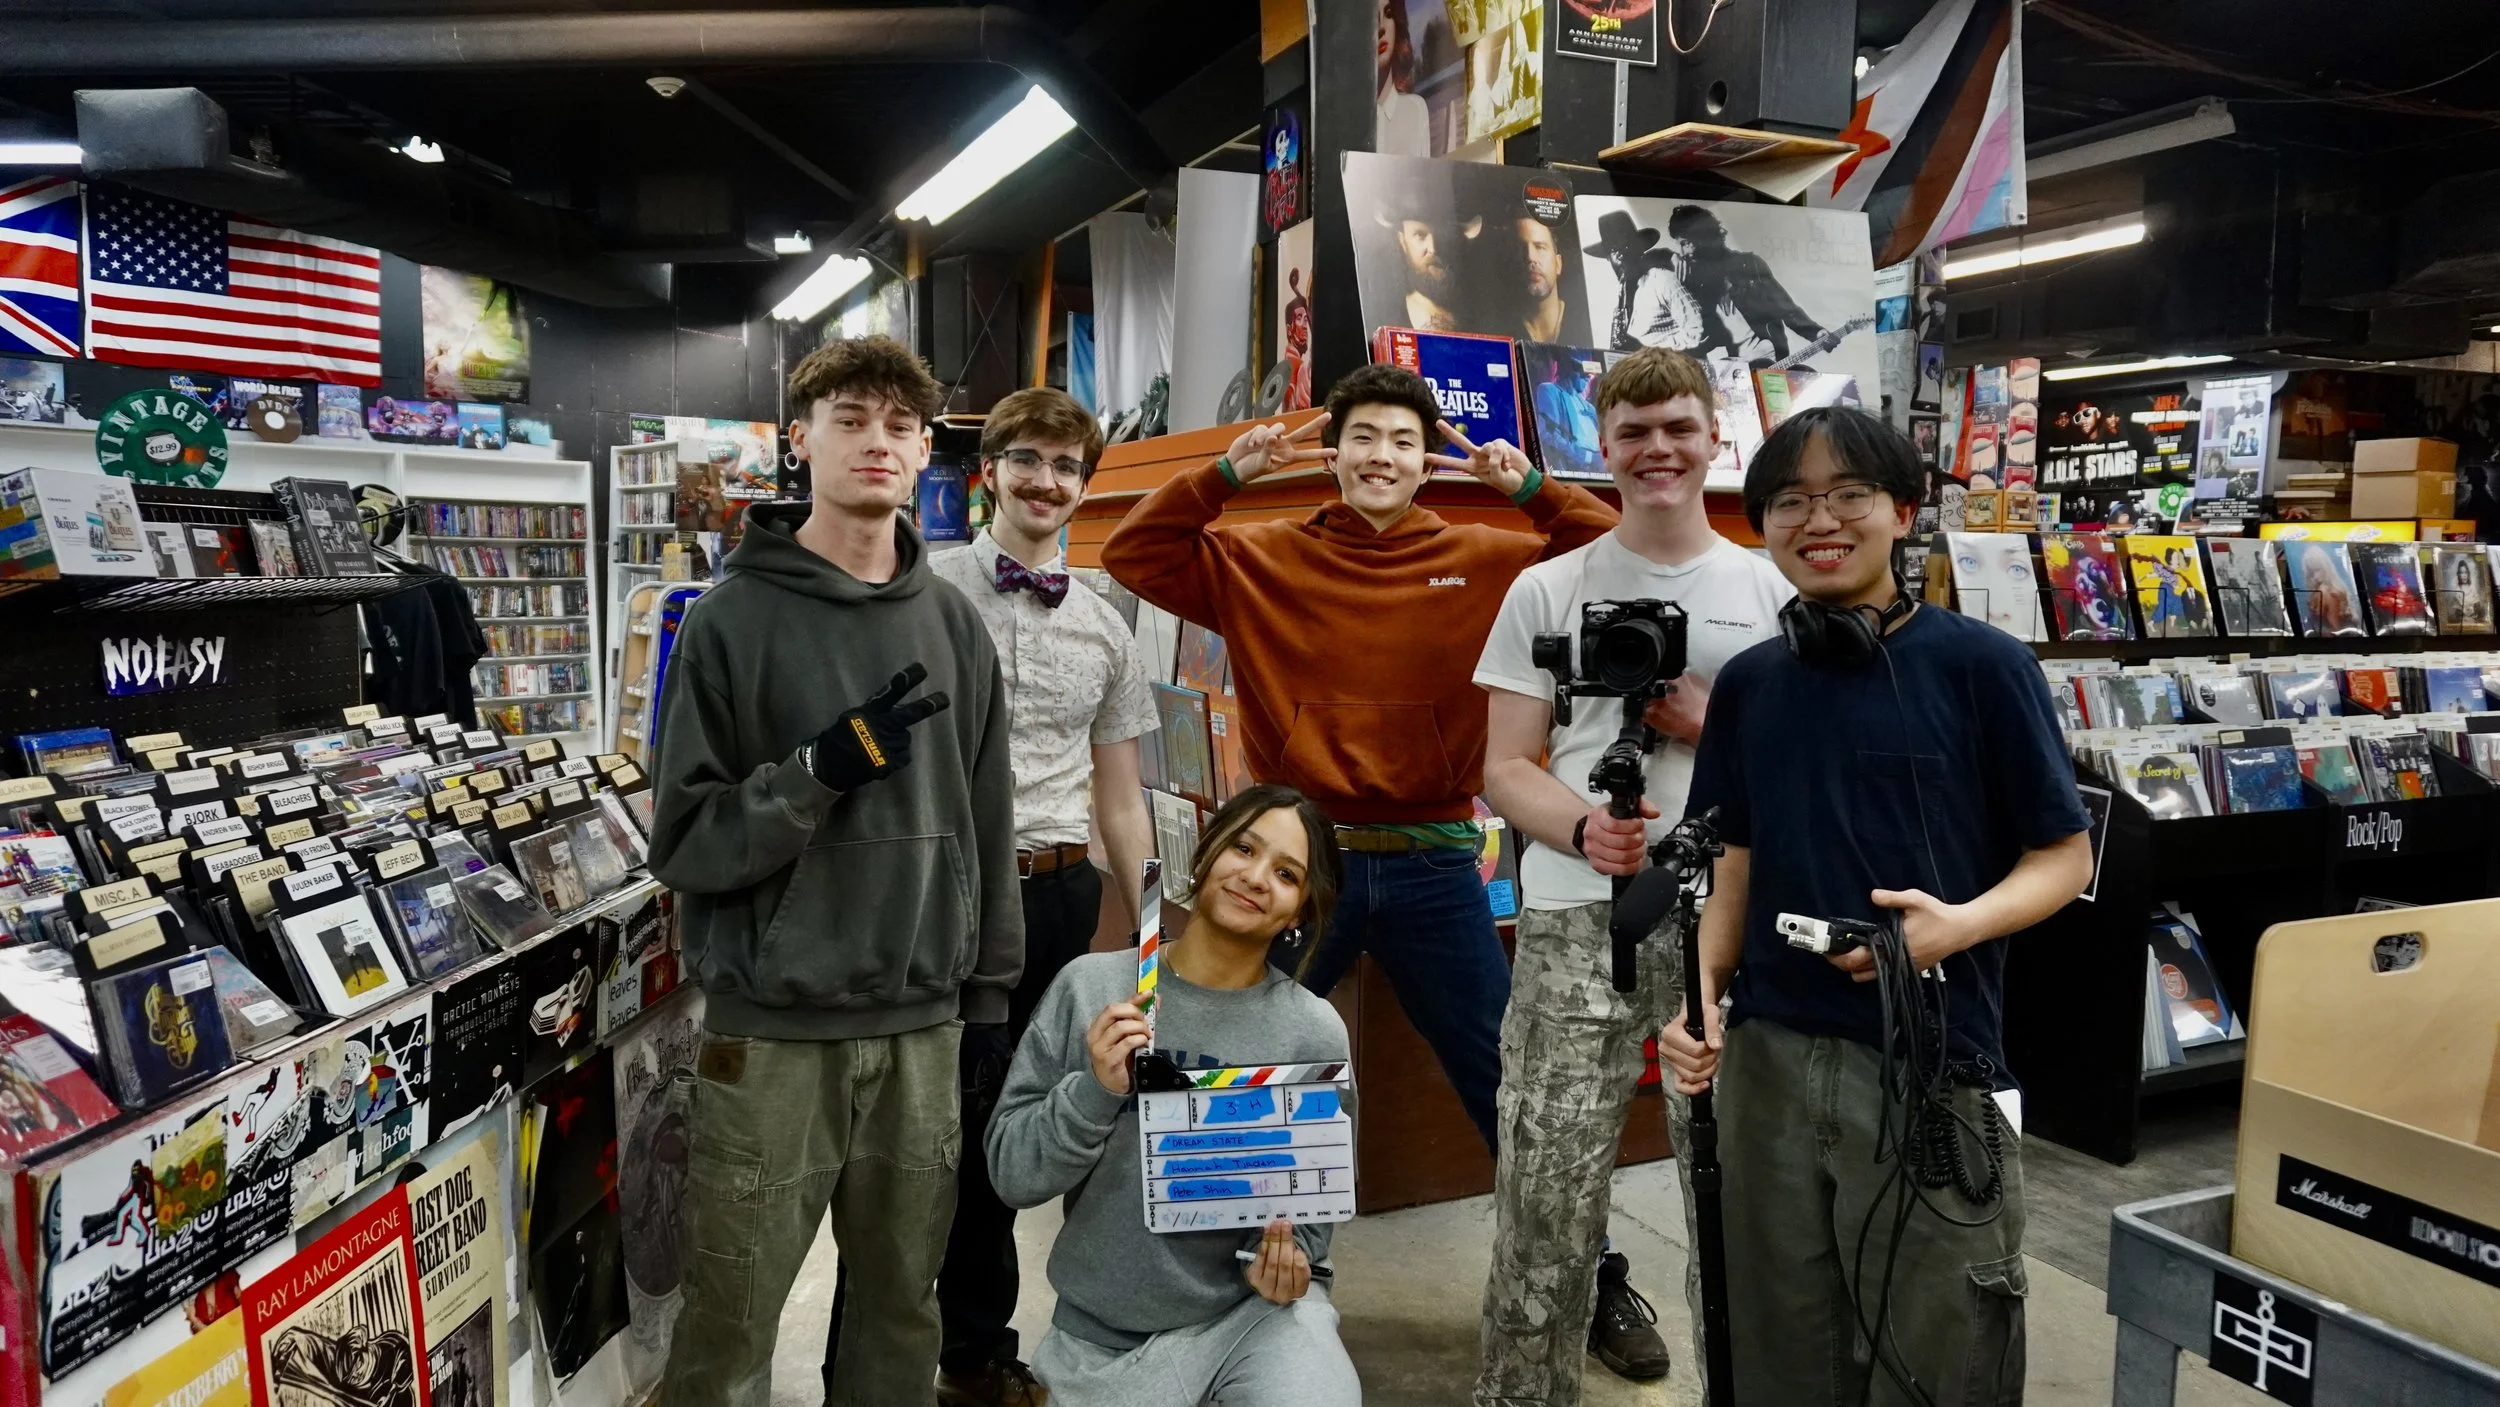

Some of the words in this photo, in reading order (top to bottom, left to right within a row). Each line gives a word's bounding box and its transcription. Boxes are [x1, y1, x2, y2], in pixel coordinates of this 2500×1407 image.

[1591, 13, 1621, 32] 25TH
[1568, 28, 1643, 44] ANNIVERSARY
[1572, 37, 1640, 51] COLLECTION
[233, 380, 265, 395] WORLD
[267, 384, 281, 394] BE
[281, 387, 303, 397] FREE
[1448, 378, 1462, 389] THE
[1424, 377, 1489, 416] BEATLES
[257, 400, 291, 414] DVDS
[101, 396, 209, 465] VINTAGE
[149, 442, 178, 456] $12.99
[2044, 457, 2082, 484] R.O.C.
[2085, 450, 2138, 481] STARS
[1428, 576, 1467, 587] XLARGE
[101, 632, 226, 690] NOEASY
[468, 733, 493, 744] CARAVAN
[246, 762, 266, 773] BISHOP
[266, 759, 285, 770] BRIGGS
[566, 762, 587, 773] CAMEL
[604, 758, 620, 768] CAKE
[2143, 764, 2171, 778] Secret
[492, 775, 499, 785] B
[275, 792, 312, 808] BLEACHERS
[103, 806, 124, 815] BLACK
[457, 804, 485, 819] BOSTON
[497, 810, 512, 823] BON
[512, 808, 527, 820] JOVI
[118, 819, 133, 829] BLACK
[131, 827, 143, 836] NEW
[144, 822, 158, 832] ROAD
[202, 825, 228, 837] ANDREW
[228, 822, 244, 834] BIRD
[2347, 810, 2402, 851] Rock/Pop
[271, 830, 287, 844] BIG
[287, 825, 311, 839] THIEF
[313, 842, 331, 855] FROND
[382, 857, 399, 872] JEFF
[400, 851, 420, 866] BECK
[238, 872, 258, 886] THE
[261, 864, 286, 881] BAND
[291, 879, 313, 892] JULIEN
[313, 872, 336, 885] BAKER
[94, 890, 129, 908] MISC.
[132, 886, 142, 899] A
[443, 998, 477, 1026] ARCTIC
[480, 976, 520, 1006] MONKEYS
[500, 996, 519, 1014] BASE
[1143, 1099, 1151, 1122] ROLL
[1226, 1101, 1237, 1116] 3
[1250, 1098, 1262, 1111] H
[1145, 1133, 1153, 1156] PROD
[1171, 1162, 1223, 1174] Hannah
[1232, 1158, 1276, 1171] Tjaden
[1173, 1187, 1197, 1198] Peter
[1204, 1185, 1232, 1195] Shin
[2288, 1178, 2373, 1219] Marshall
[409, 1183, 443, 1239] LOST
[444, 1164, 473, 1216] DOG
[1296, 1211, 1309, 1219] NITE
[453, 1196, 487, 1253] BAND
[256, 1284, 290, 1324] RAY
[293, 1206, 402, 1299] LAMONTAGNE
[425, 1250, 471, 1302] SURVIVED
